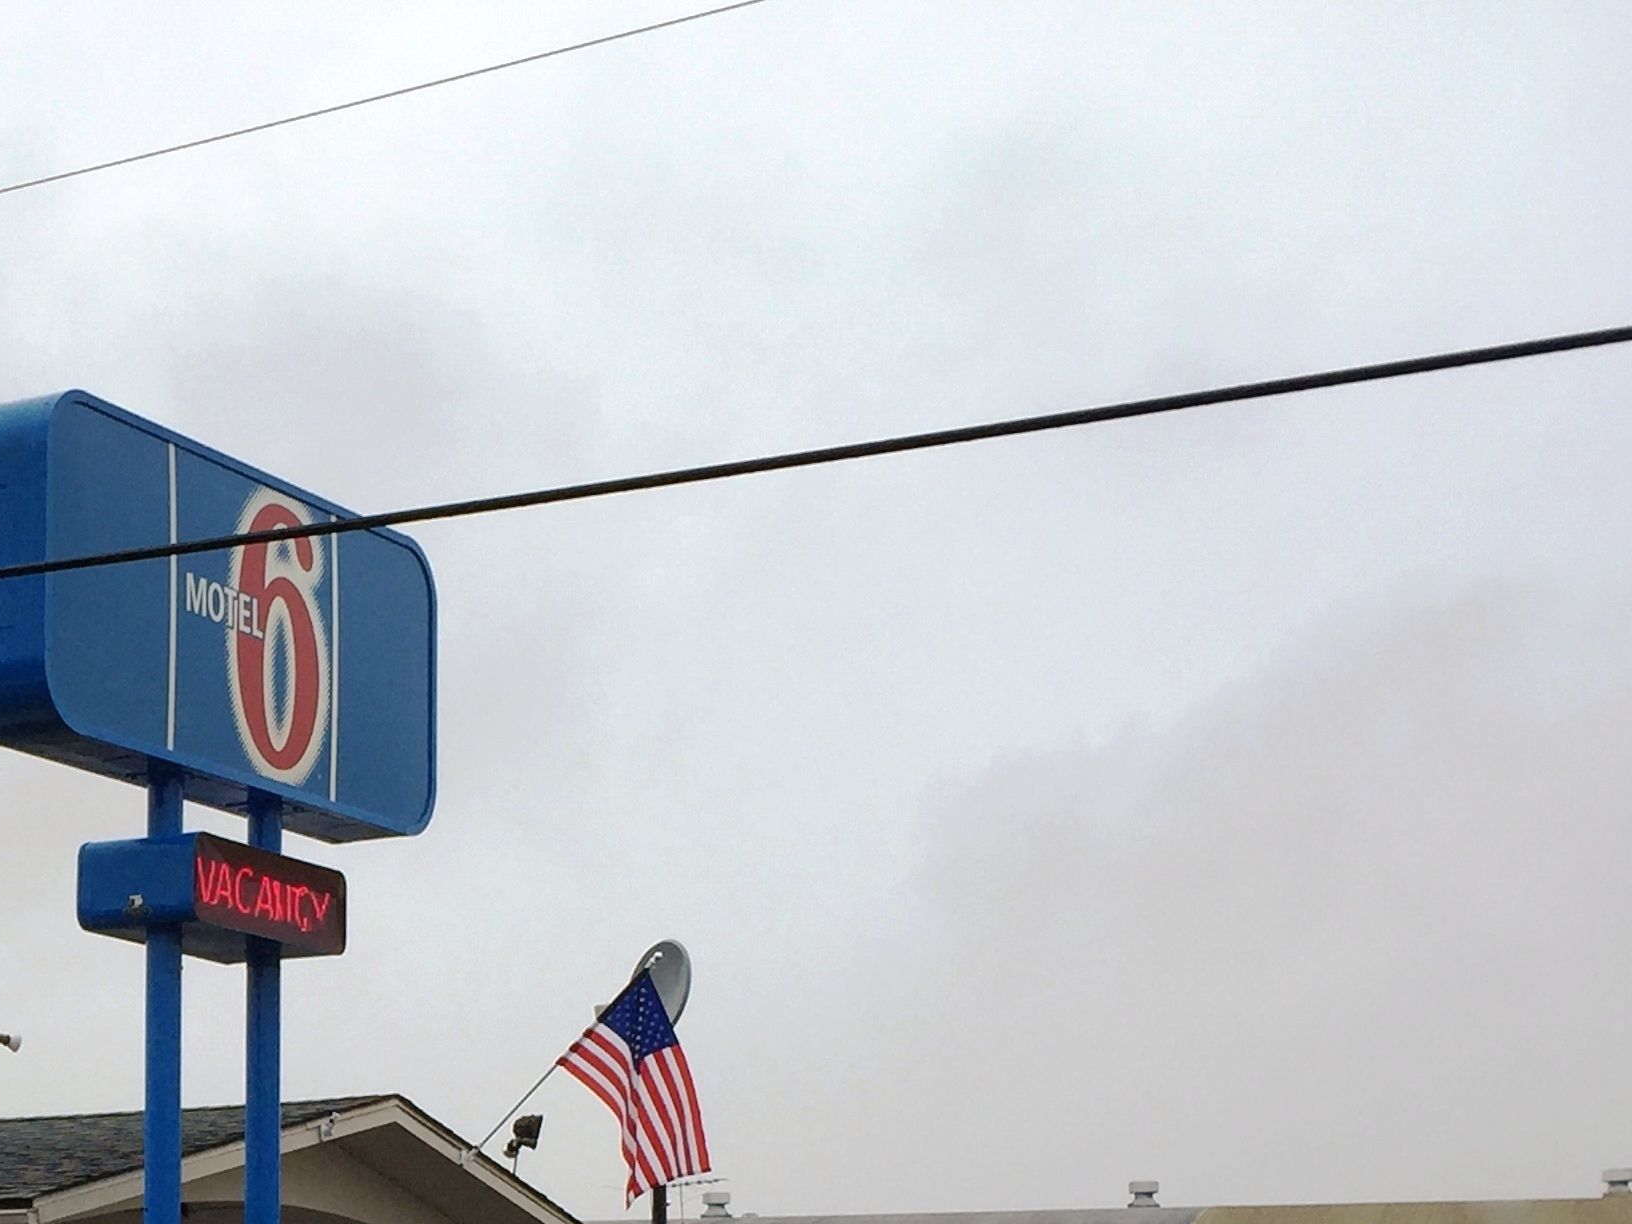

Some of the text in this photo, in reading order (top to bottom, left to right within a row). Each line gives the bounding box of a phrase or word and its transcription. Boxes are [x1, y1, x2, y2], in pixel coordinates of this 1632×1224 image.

[186, 494, 325, 779] MOTEL 6
[197, 856, 330, 932] VACANCY
